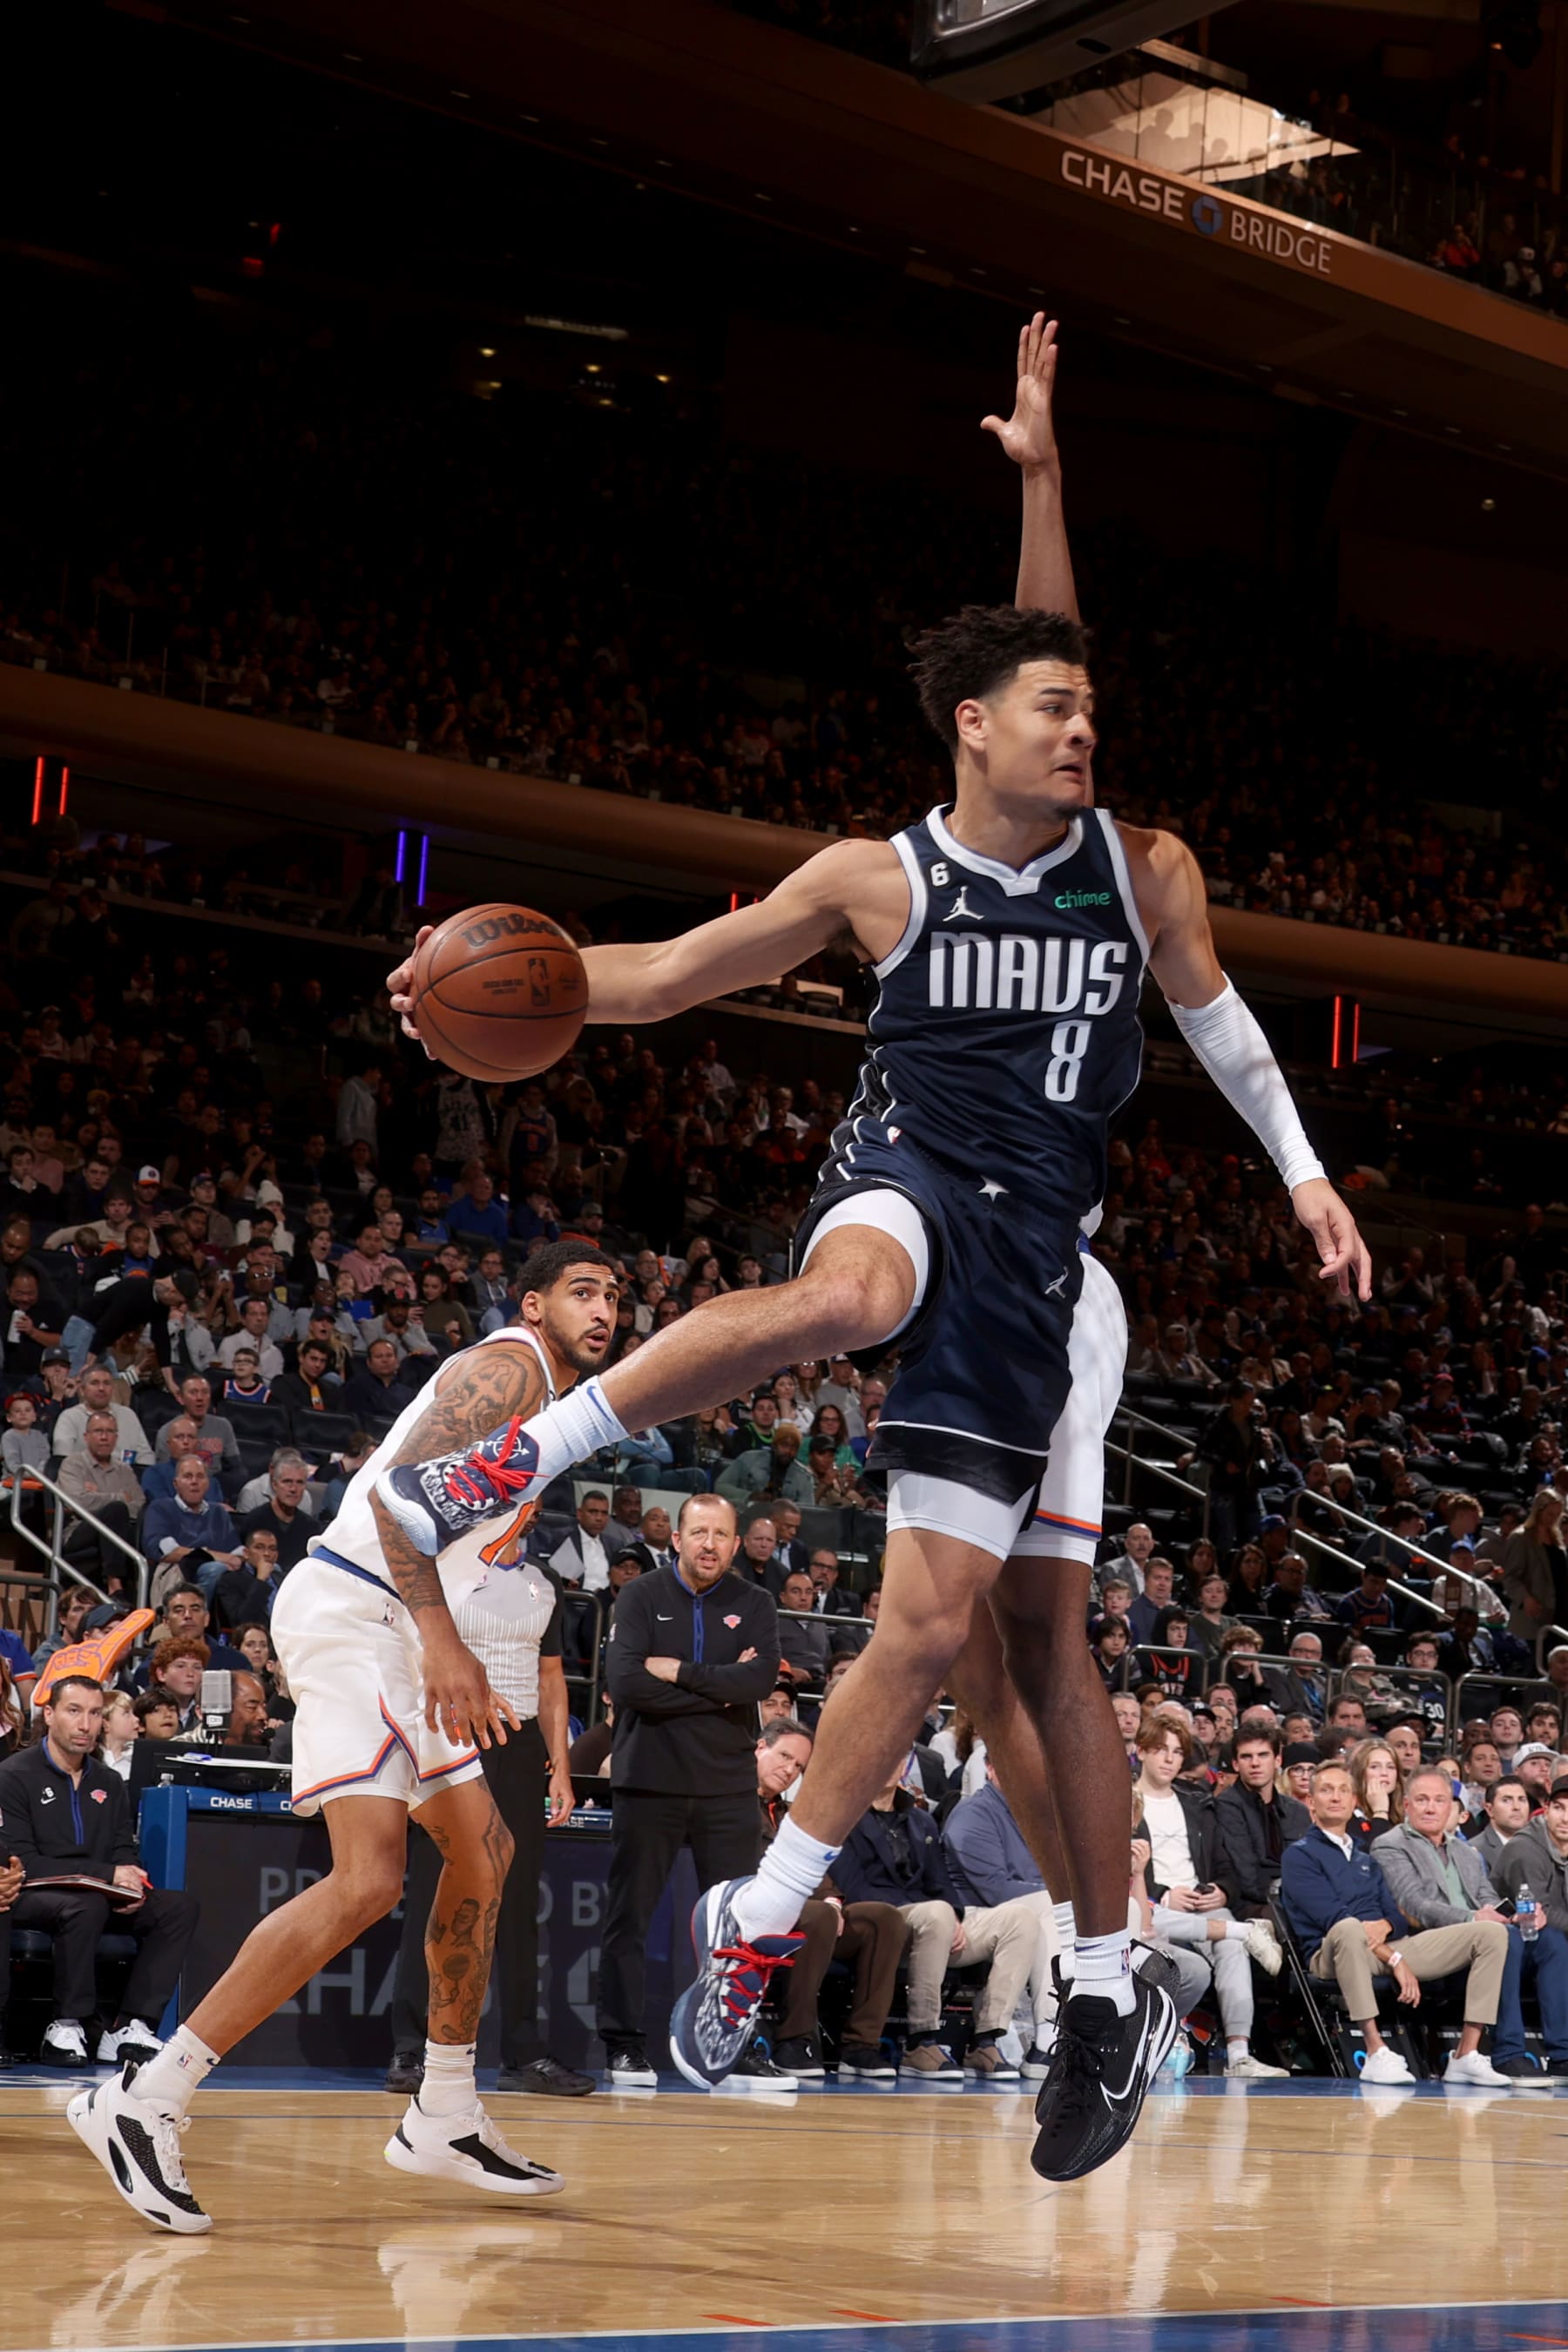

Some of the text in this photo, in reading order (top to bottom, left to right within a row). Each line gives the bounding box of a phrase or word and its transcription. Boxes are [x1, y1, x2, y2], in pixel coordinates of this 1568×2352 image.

[1061, 151, 1331, 274] CHASE BRIDGE
[930, 862, 950, 887] 6
[1054, 889, 1112, 909] chime
[929, 931, 1129, 1016] MAVS
[1044, 1019, 1092, 1103] 8
[1424, 1702, 1444, 1720] 30
[210, 1796, 253, 1809] CHASE
